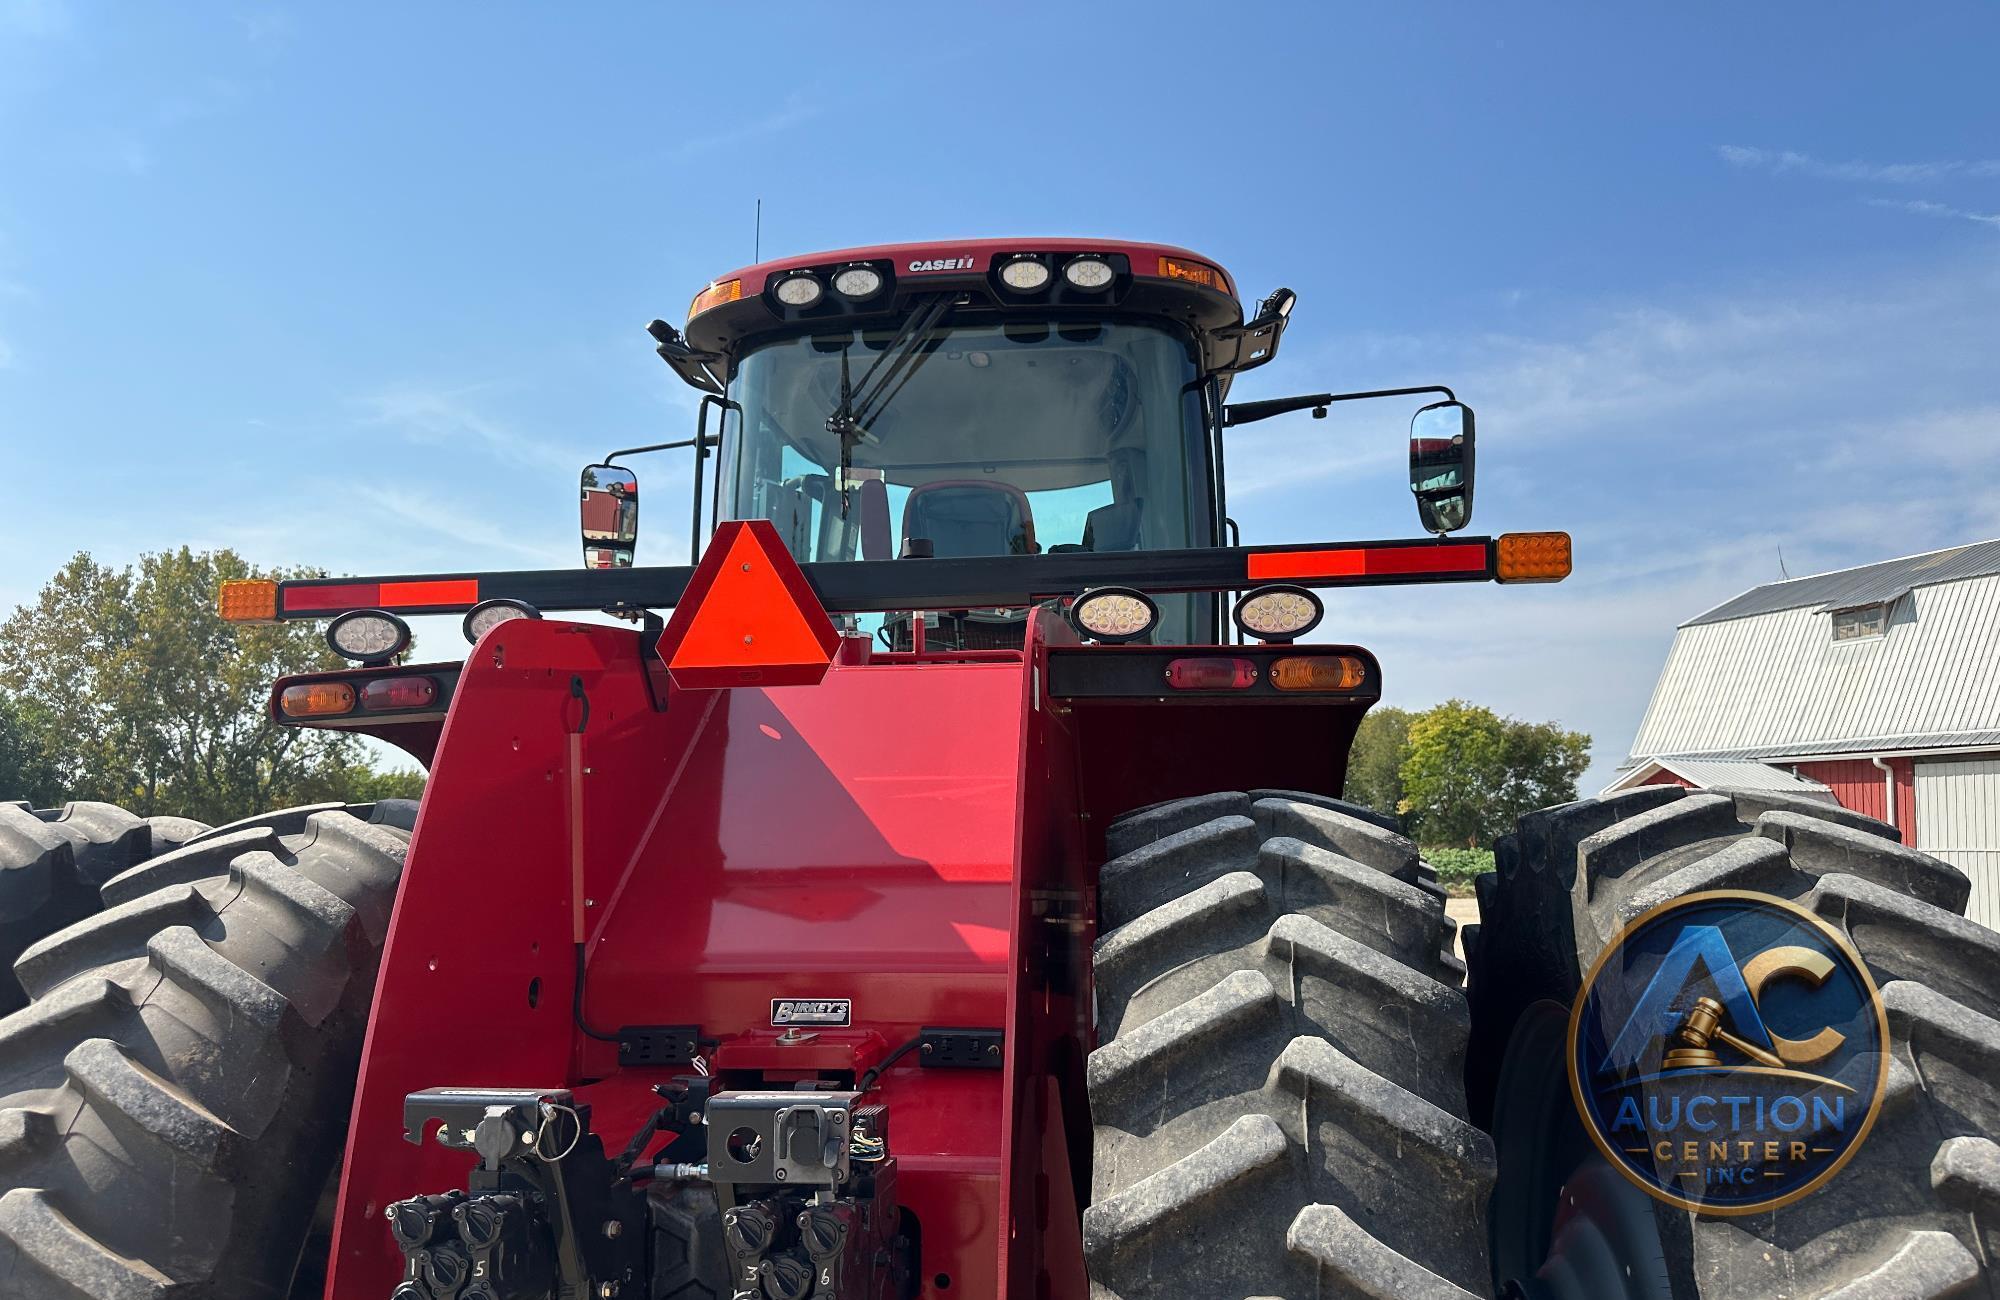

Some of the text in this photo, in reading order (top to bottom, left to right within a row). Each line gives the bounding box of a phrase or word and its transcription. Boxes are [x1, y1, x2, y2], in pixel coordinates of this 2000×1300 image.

[909, 259, 956, 272] CASE
[773, 1002, 848, 1022] BIRKEY'S
[473, 1260, 486, 1277] 5
[745, 1265, 758, 1281] 3
[820, 1267, 830, 1285] 6
